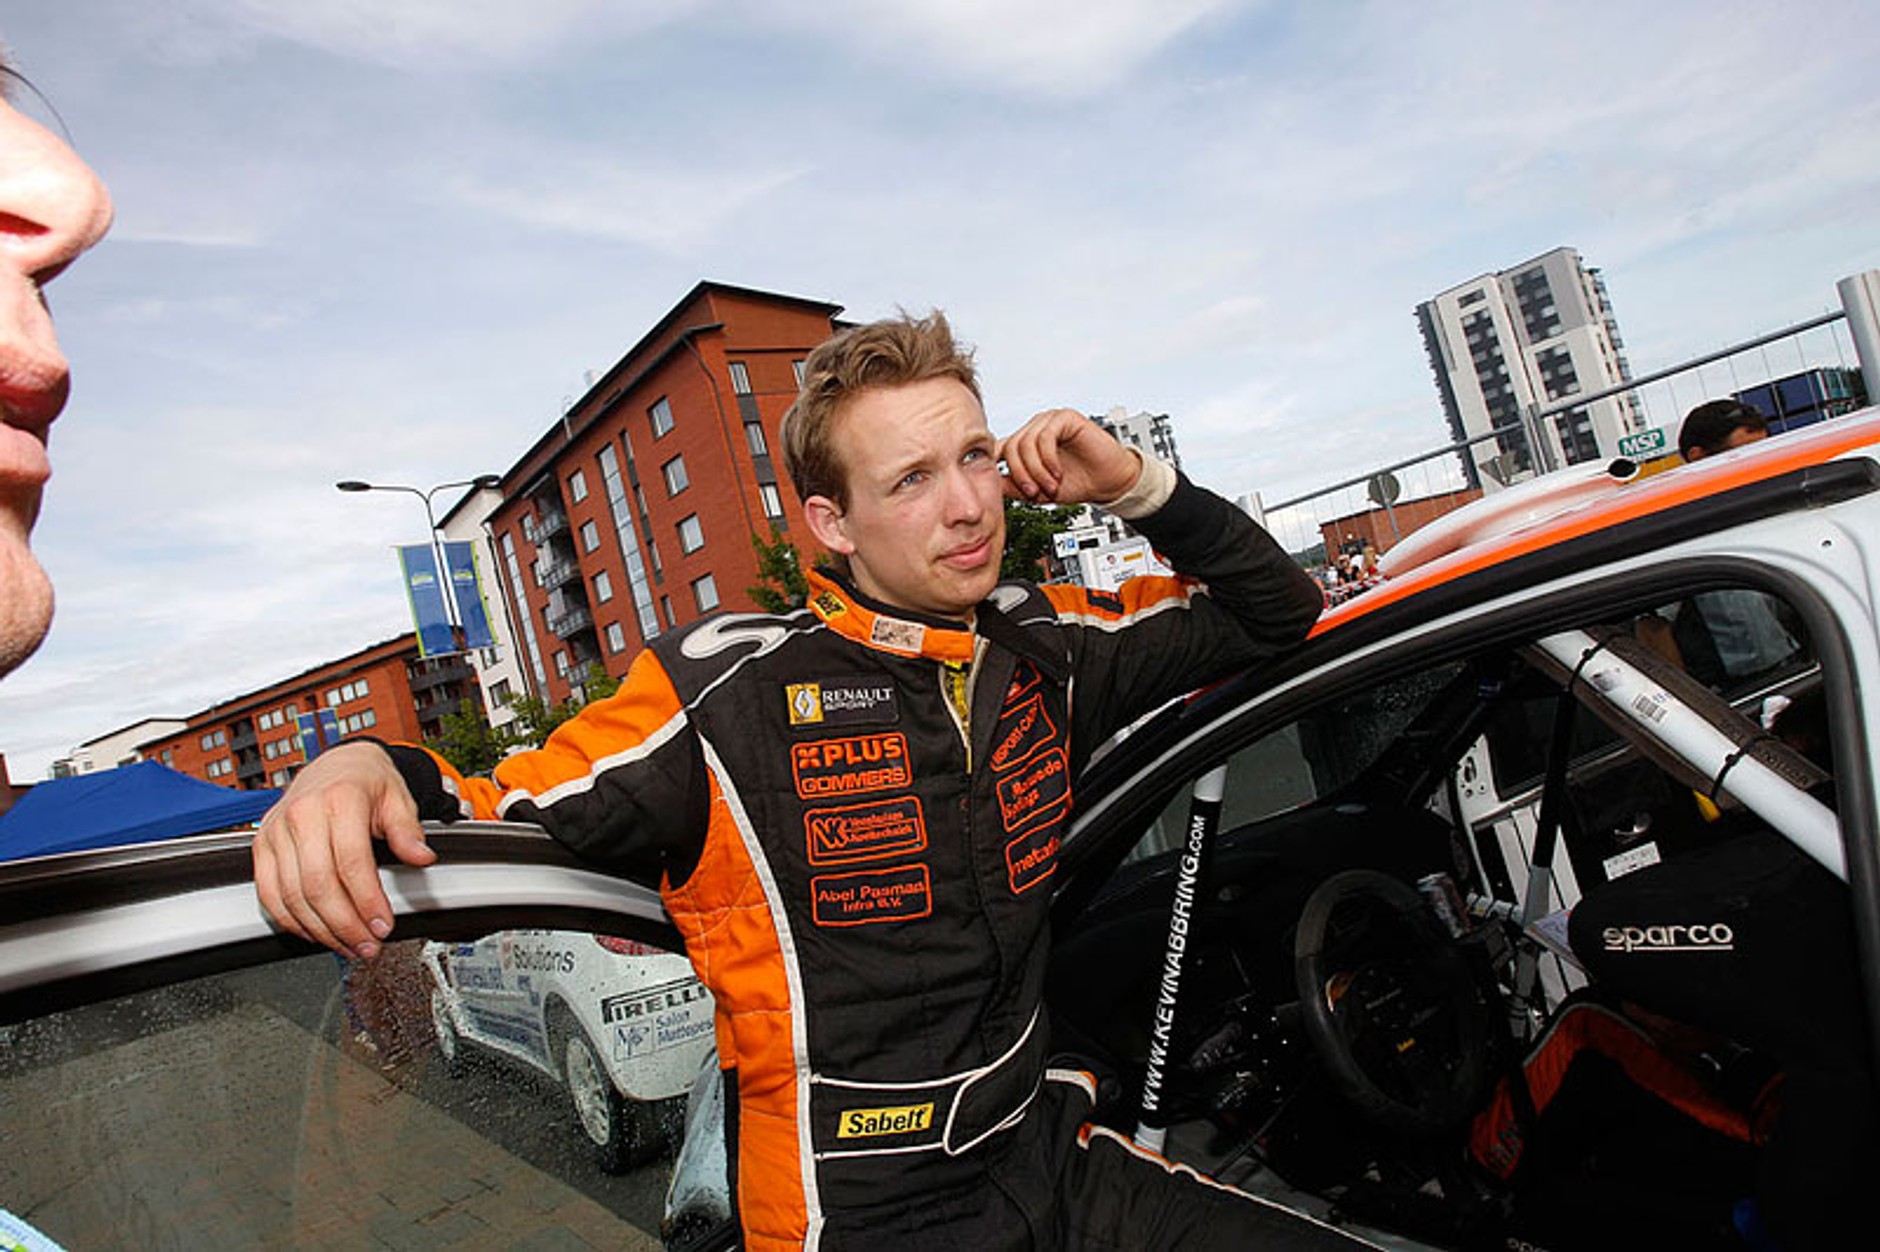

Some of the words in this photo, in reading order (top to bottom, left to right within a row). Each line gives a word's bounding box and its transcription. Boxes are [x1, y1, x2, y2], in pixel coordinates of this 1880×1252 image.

[1623, 432, 1661, 456] MSP
[822, 688, 893, 702] RENAULT
[822, 737, 902, 767] PLUS
[801, 767, 906, 793] GOMMERS
[818, 888, 855, 903] Abel
[843, 900, 874, 912] Infra
[1602, 923, 1734, 952] sparco
[1142, 815, 1206, 1111] WWW.KEVINABBRING.COM
[847, 1109, 928, 1135] Sabelt
